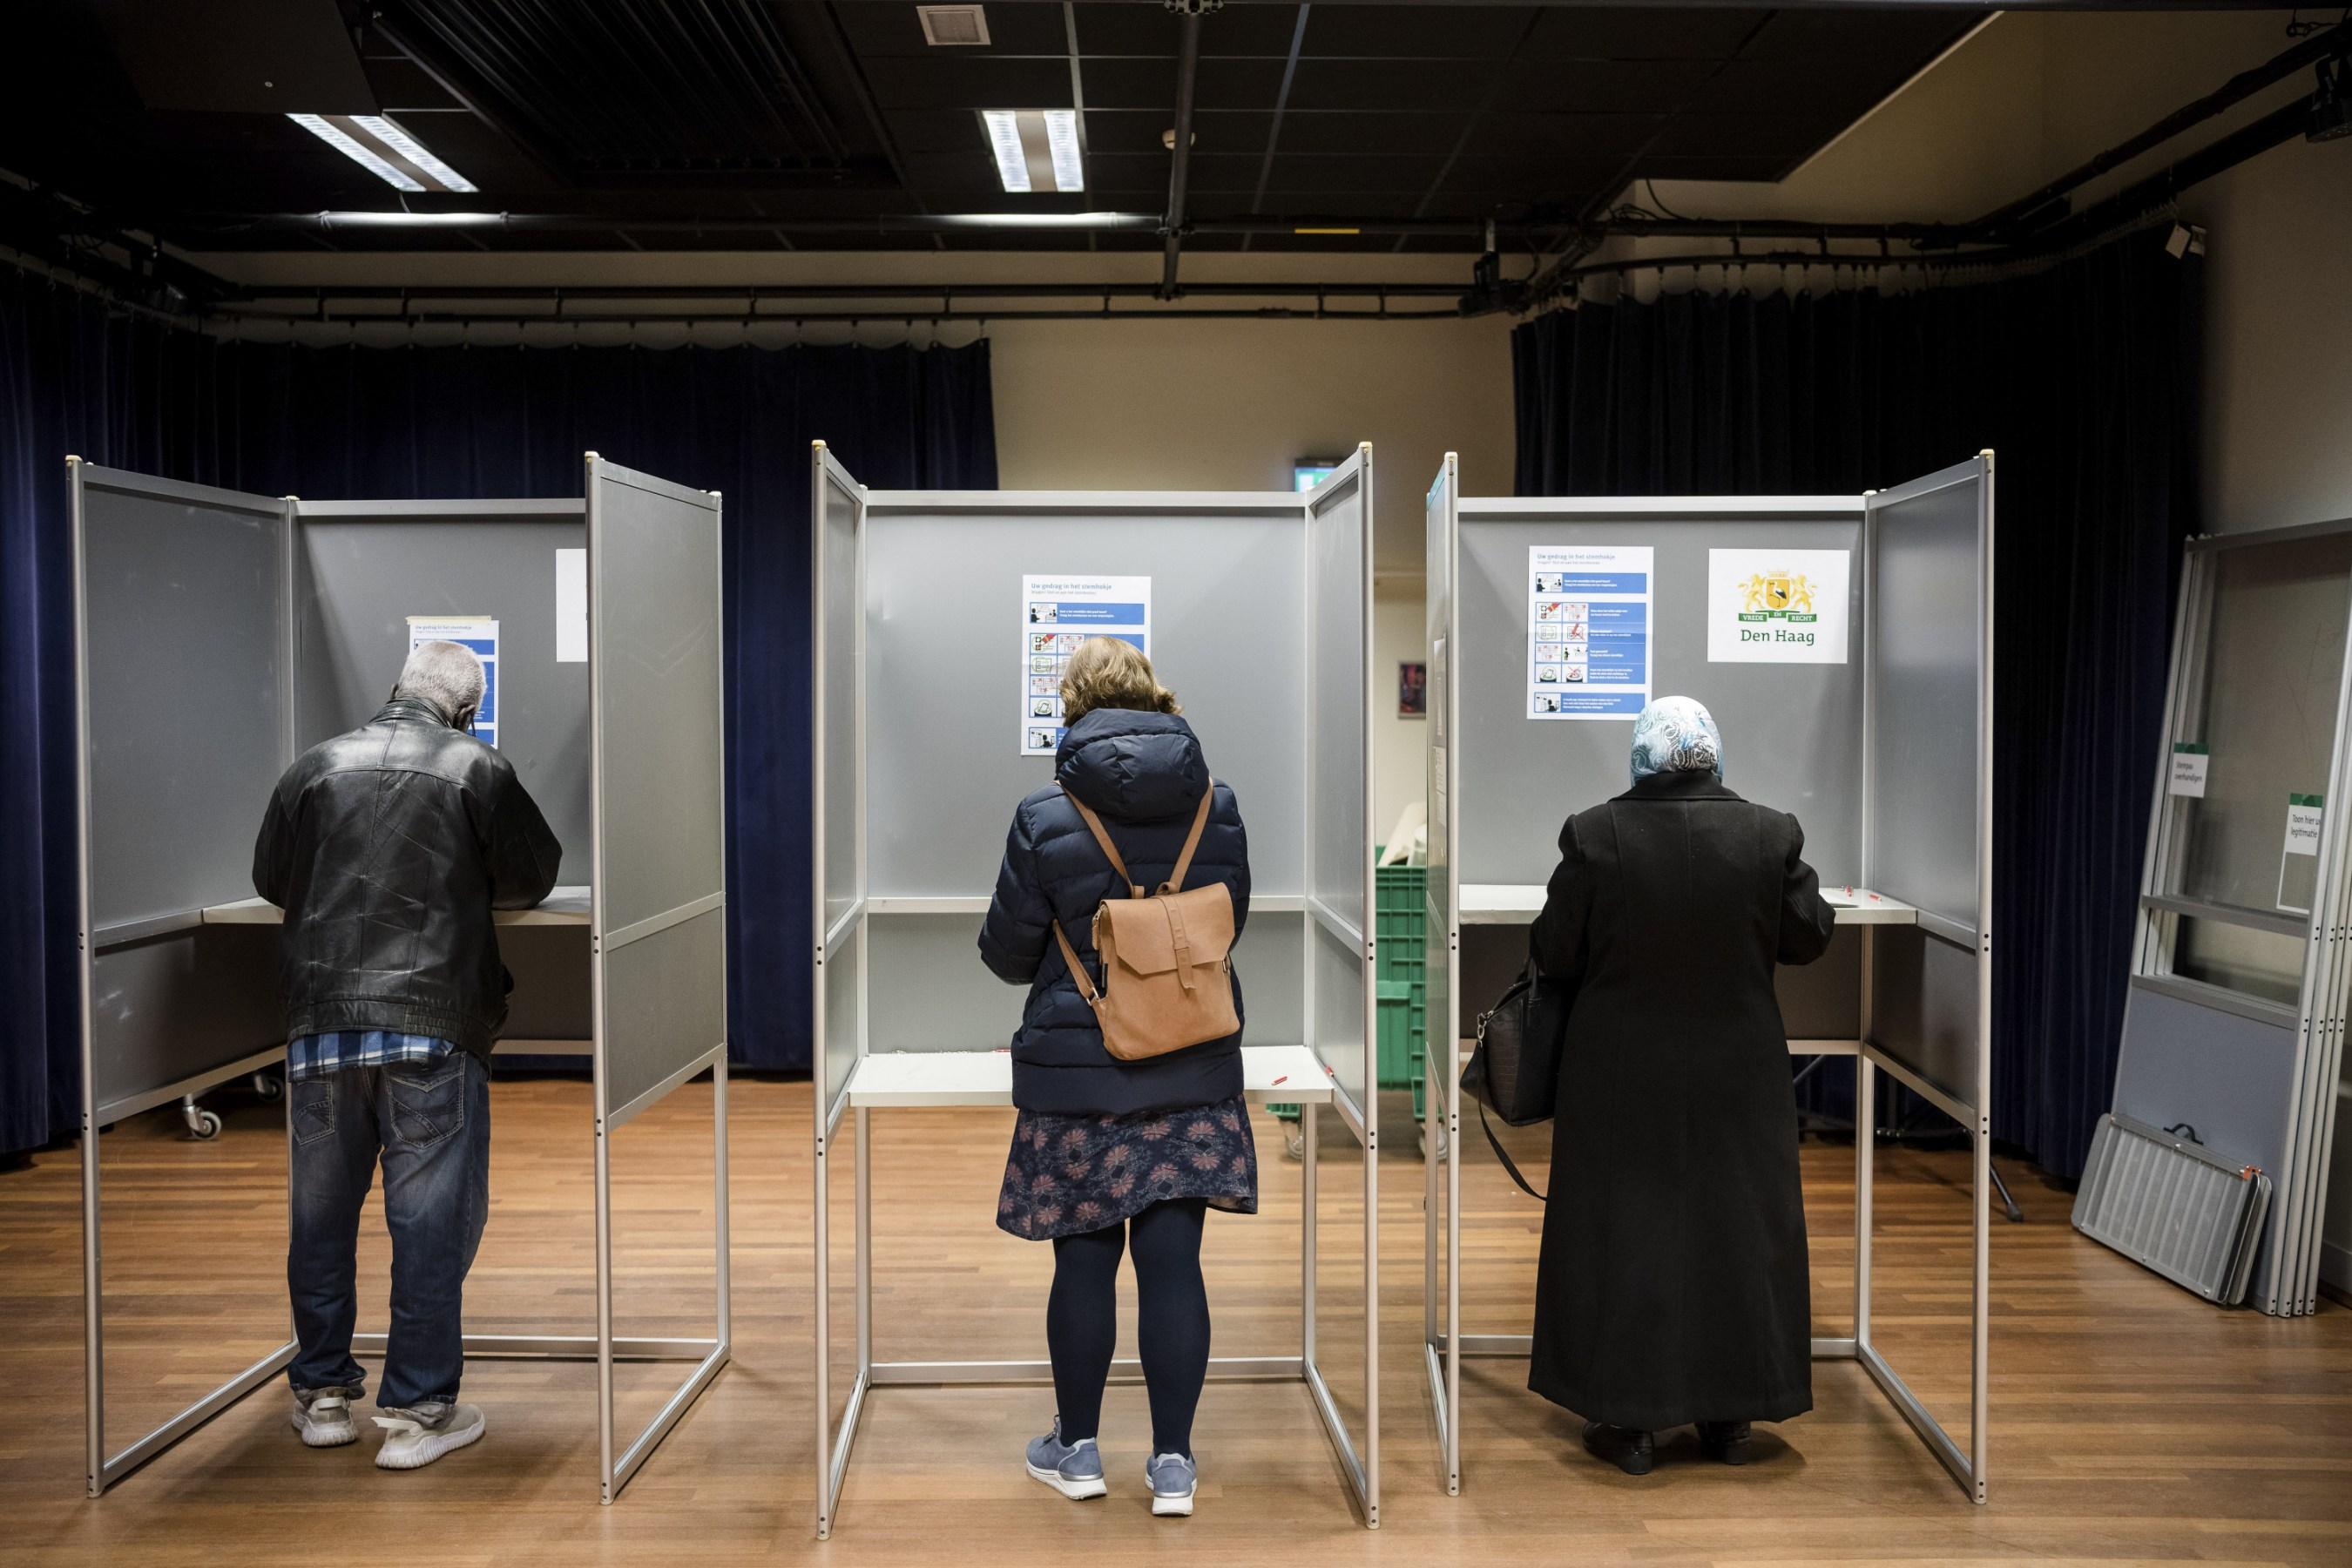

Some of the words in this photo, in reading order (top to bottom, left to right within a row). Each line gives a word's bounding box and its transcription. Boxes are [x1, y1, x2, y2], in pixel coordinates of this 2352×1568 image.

[1740, 629, 1770, 642] Den
[1774, 629, 1815, 646] Haag
[2292, 814, 2304, 823] Toon
[2304, 815, 2315, 825] hier
[2291, 827, 2317, 839] legitimatie
